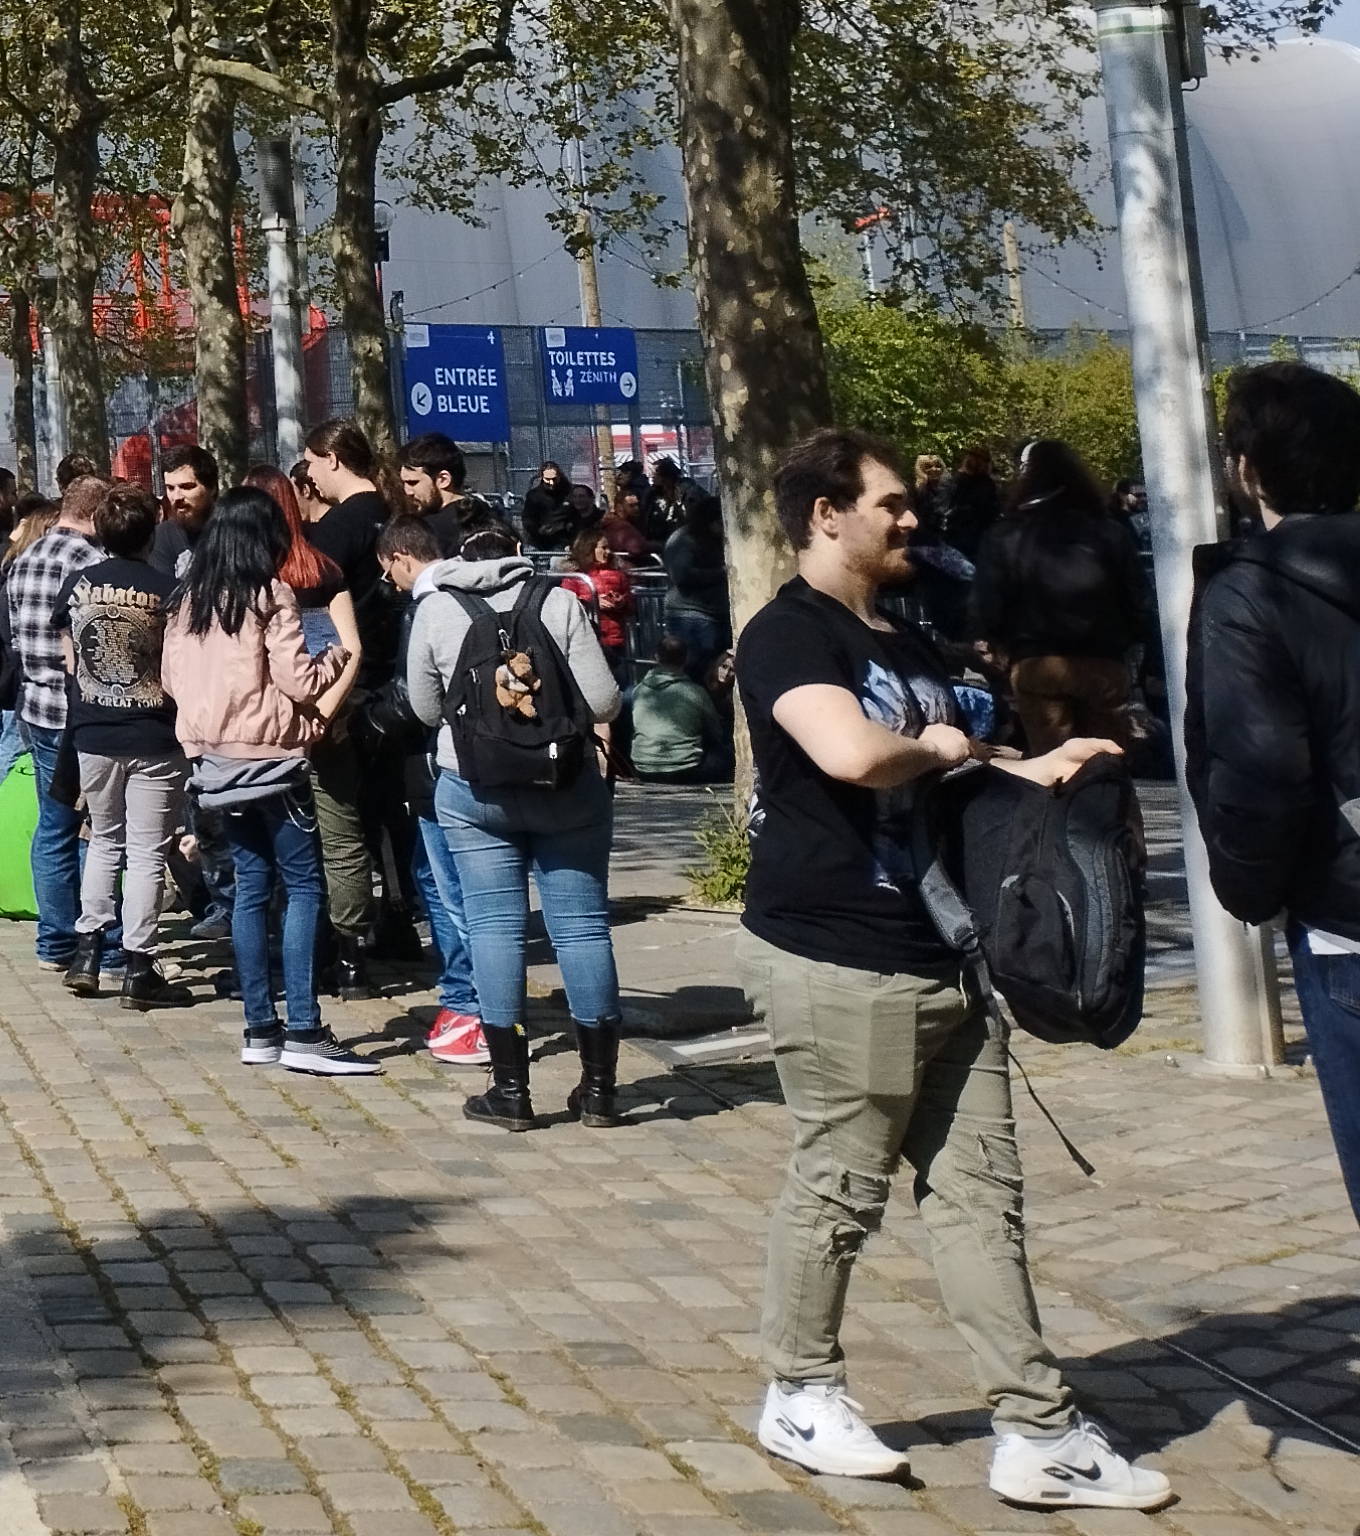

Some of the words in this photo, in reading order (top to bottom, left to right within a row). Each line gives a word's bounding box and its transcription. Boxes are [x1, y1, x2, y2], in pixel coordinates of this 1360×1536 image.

[548, 350, 616, 366] TOILETTES
[434, 364, 498, 387] ENTRÉE
[580, 369, 617, 384] ZÉNITH
[437, 394, 490, 414] BLEUE
[97, 696, 133, 708] GREAT
